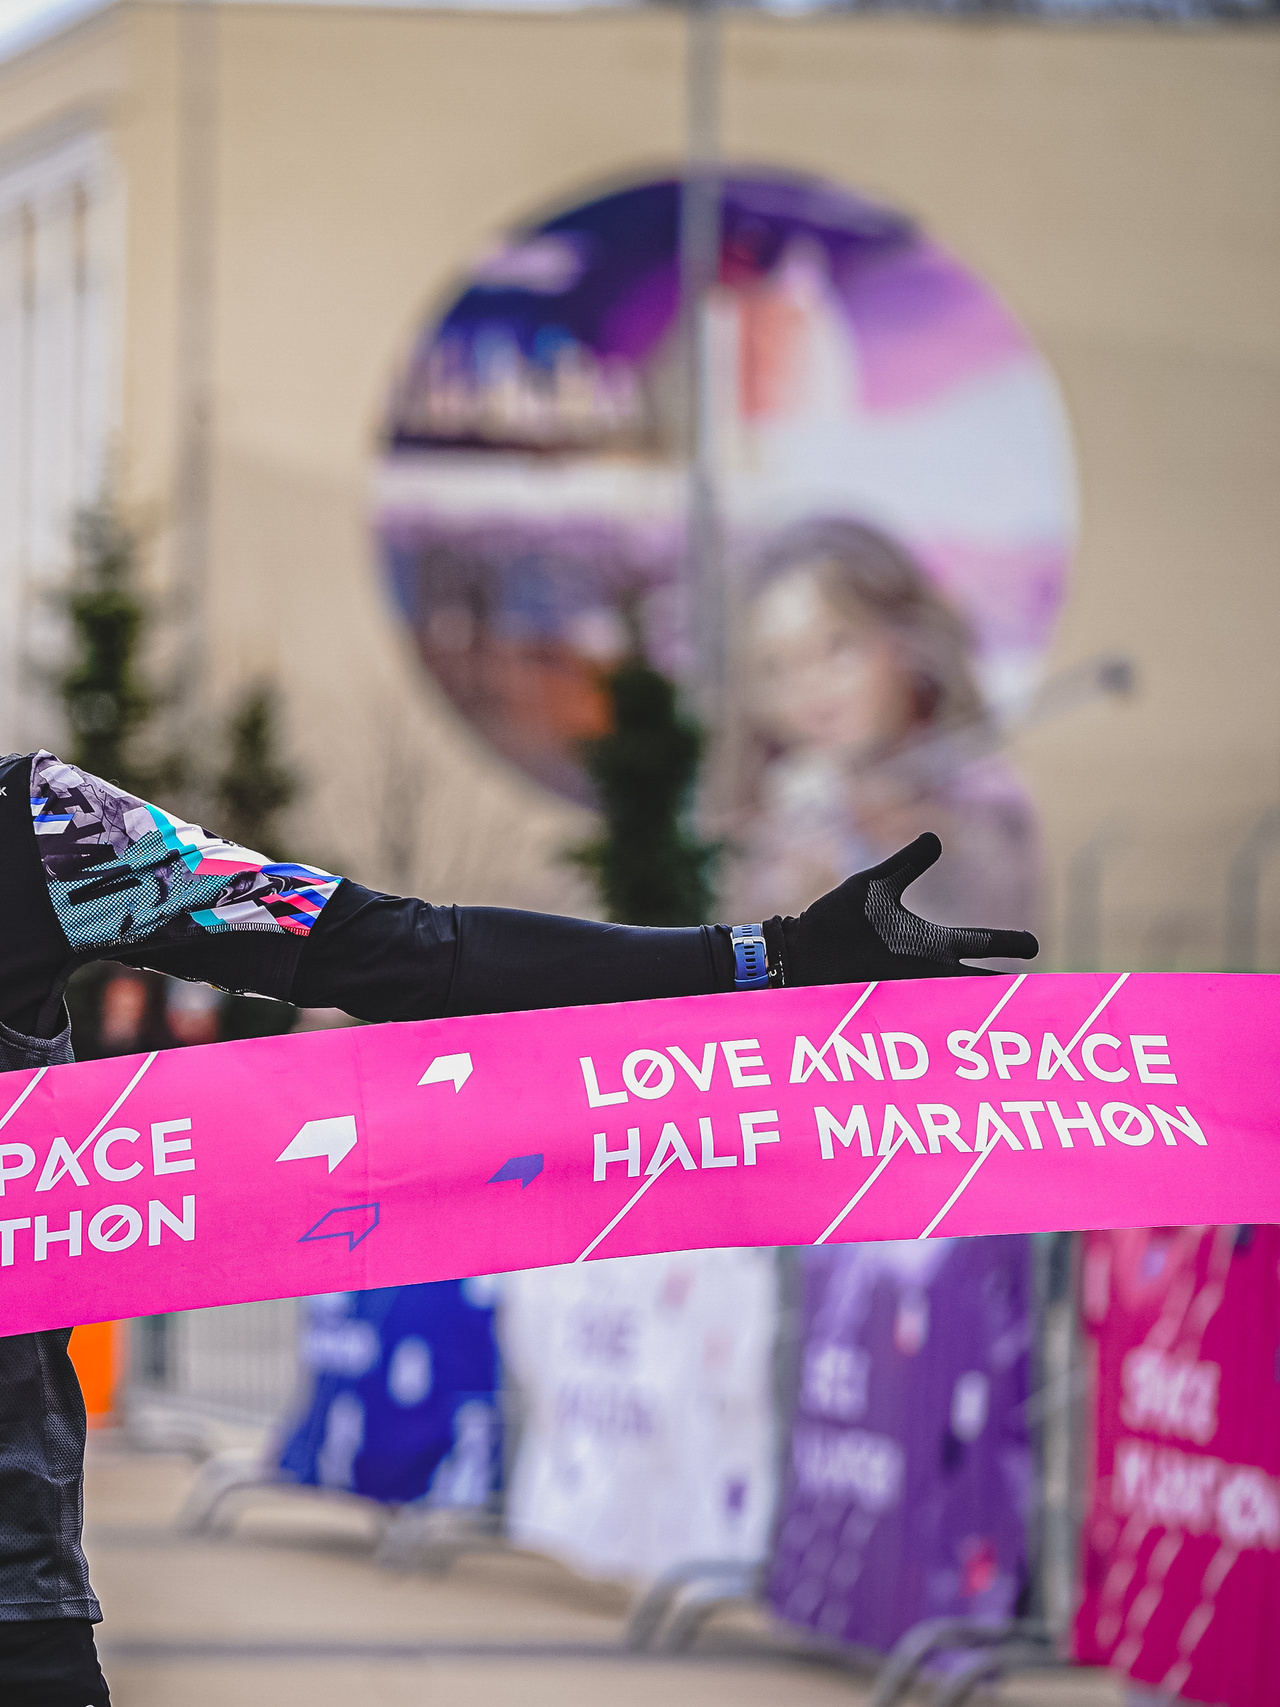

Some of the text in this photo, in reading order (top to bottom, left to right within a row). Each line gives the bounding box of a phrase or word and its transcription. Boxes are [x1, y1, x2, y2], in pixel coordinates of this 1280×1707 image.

[789, 1031, 930, 1084] AND
[947, 1029, 1178, 1085] SPACE
[593, 1109, 781, 1182] HALF
